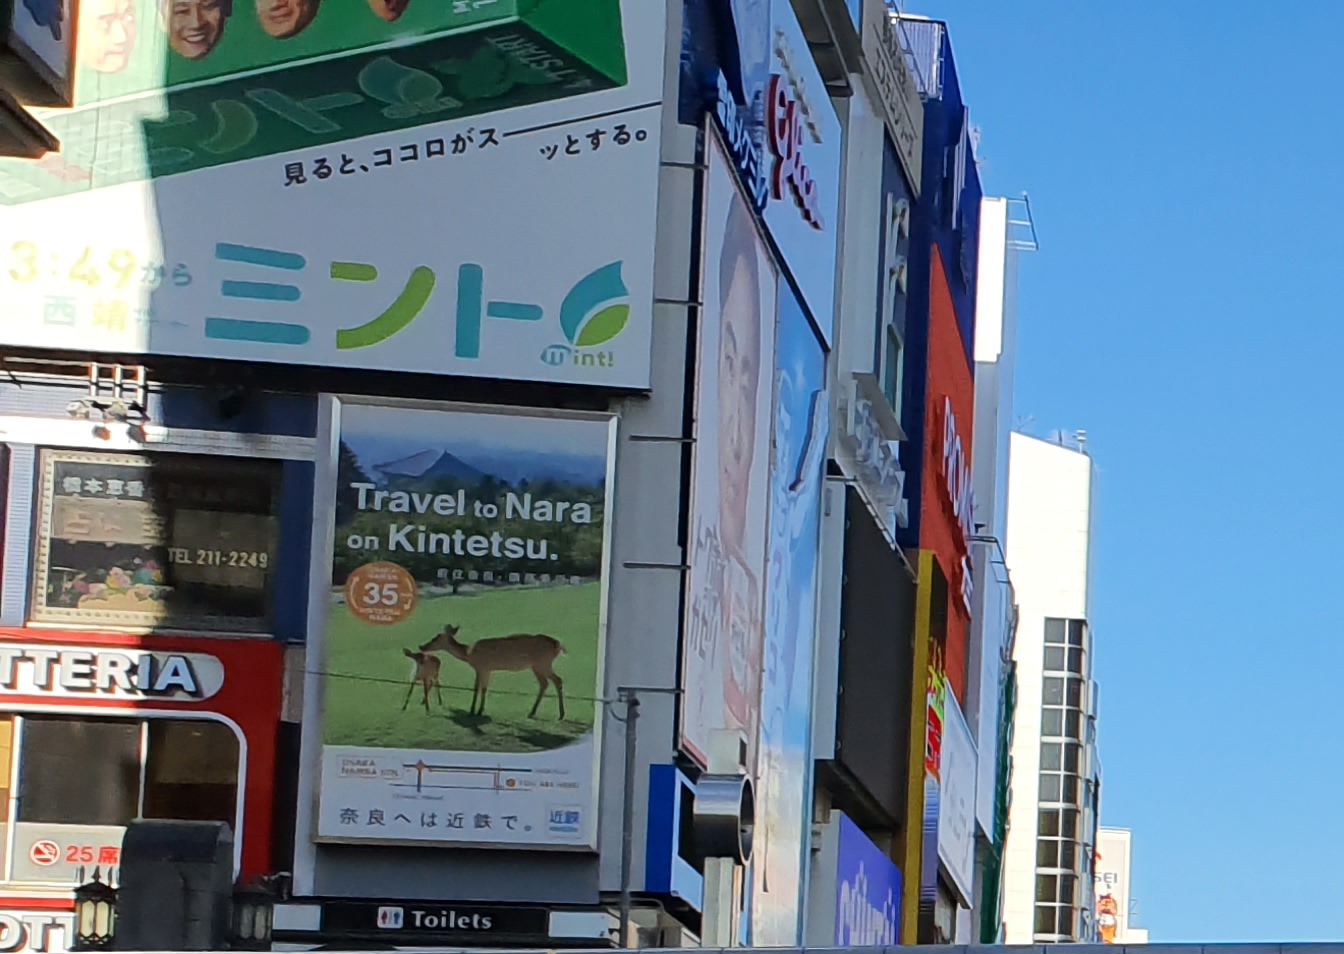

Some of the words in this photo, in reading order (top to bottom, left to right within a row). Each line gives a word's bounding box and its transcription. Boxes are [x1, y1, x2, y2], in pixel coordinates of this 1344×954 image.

[205, 242, 543, 358] ミント
[350, 482, 465, 516] Travel
[474, 500, 498, 519] to
[505, 492, 592, 524] Nara
[347, 535, 379, 550] on
[388, 524, 559, 561] Kintetsu.
[168, 548, 192, 564] TEL
[196, 550, 268, 568] 211-2249
[362, 582, 399, 606] 35
[339, 807, 533, 833] 奈良へは近鉄で。
[549, 810, 580, 825] 近鉄
[410, 910, 492, 930] Toilets
